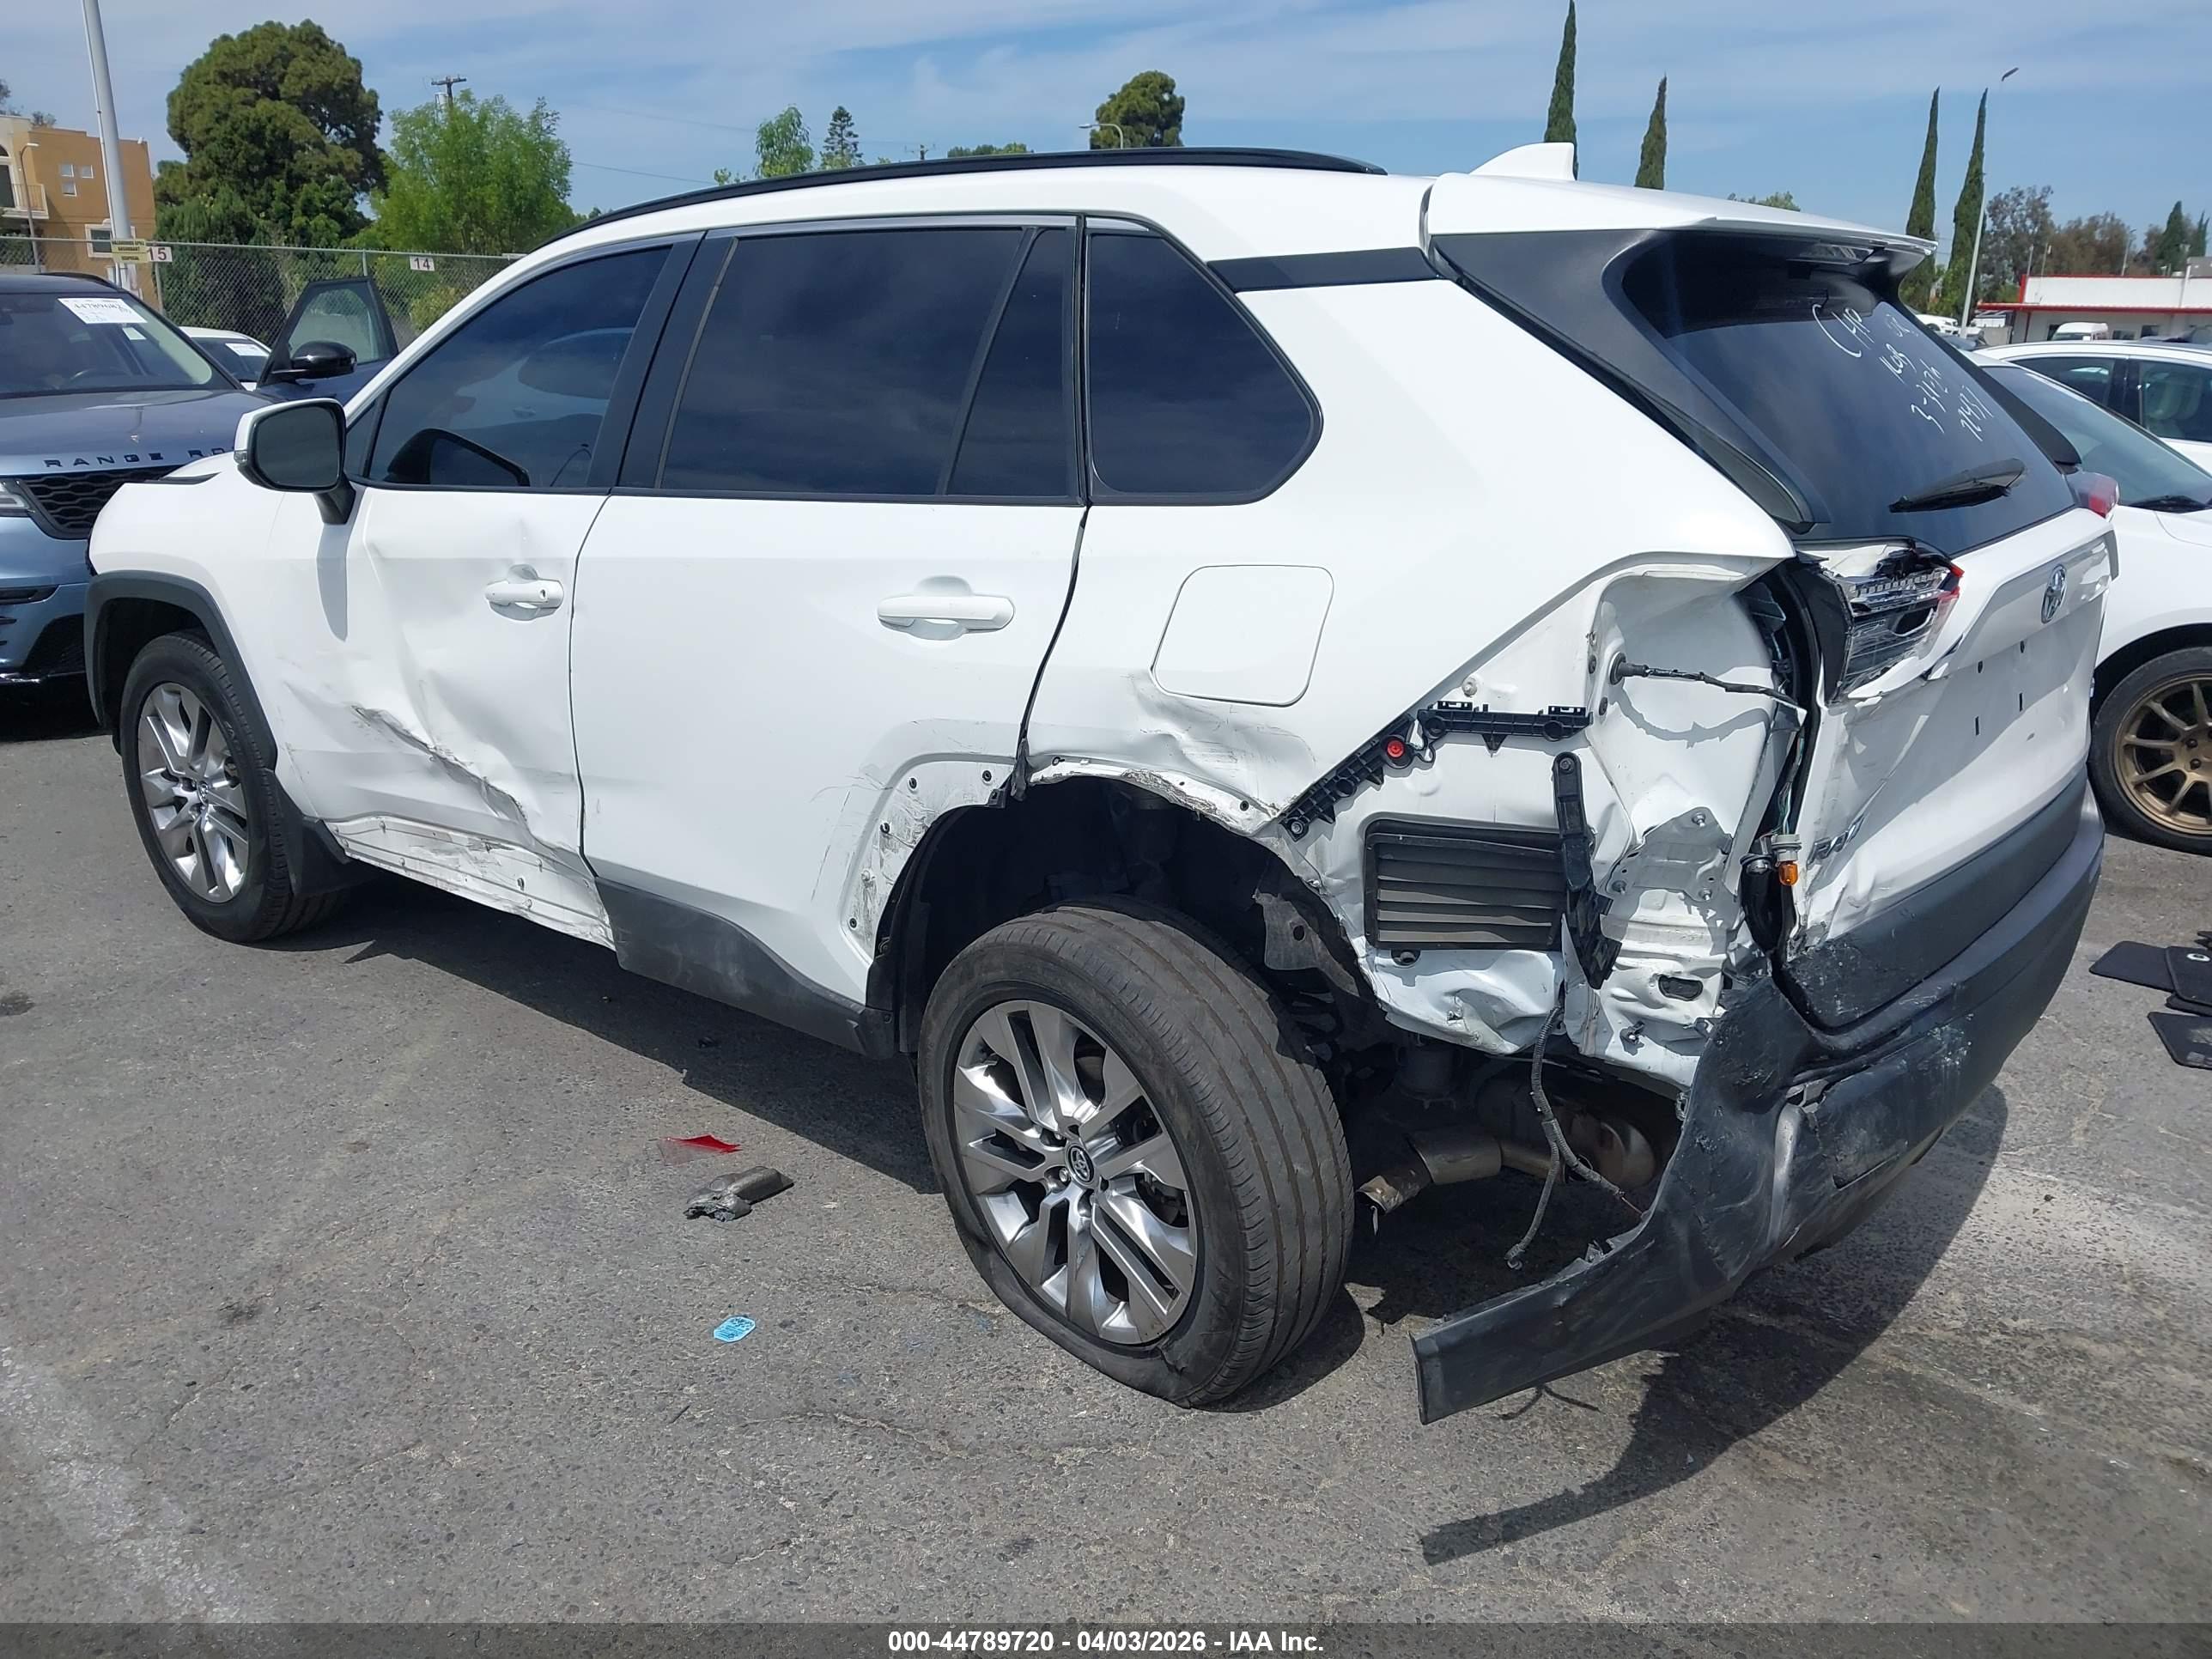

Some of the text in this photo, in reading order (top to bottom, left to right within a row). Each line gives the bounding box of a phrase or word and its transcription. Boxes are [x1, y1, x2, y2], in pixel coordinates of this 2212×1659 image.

[148, 247, 167, 261] 15
[414, 257, 431, 270] 14
[44, 453, 163, 468] RANGE
